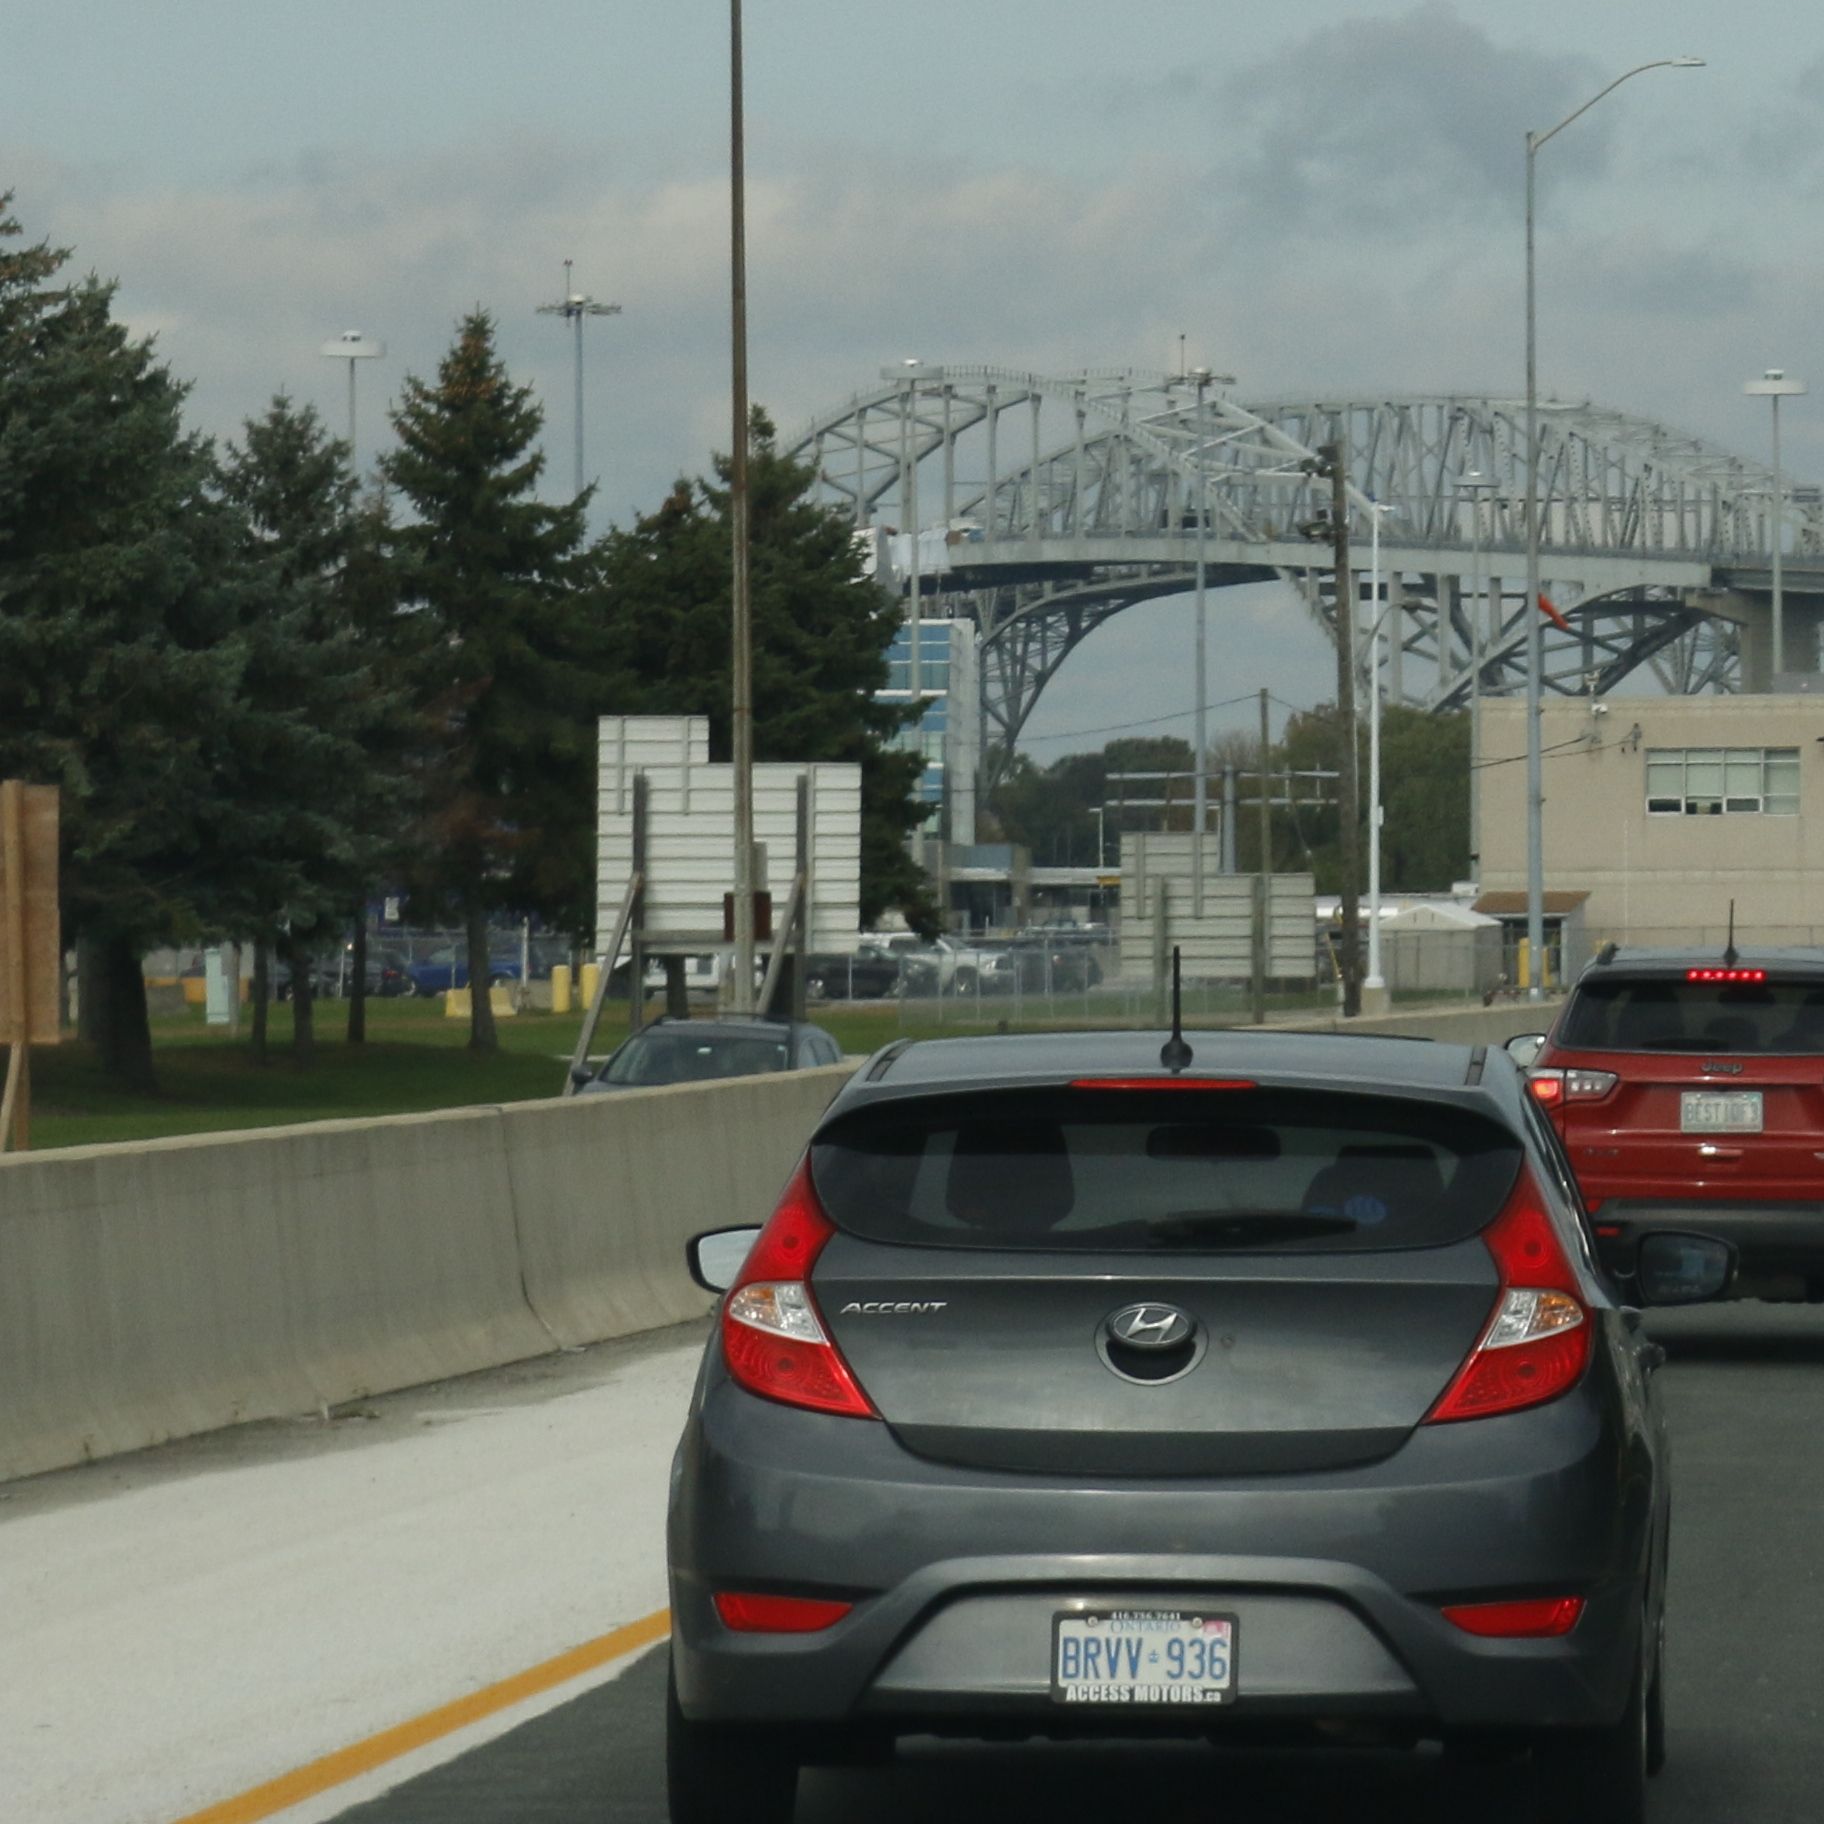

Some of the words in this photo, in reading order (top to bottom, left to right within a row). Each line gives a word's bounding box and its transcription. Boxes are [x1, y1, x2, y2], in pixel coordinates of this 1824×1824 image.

[1702, 1060, 1743, 1074] Jeep
[840, 1302, 948, 1314] ACCENT
[1062, 1637, 1143, 1679] BRVV
[1166, 1637, 1228, 1680] 936
[1066, 1685, 1131, 1702] ACCESS
